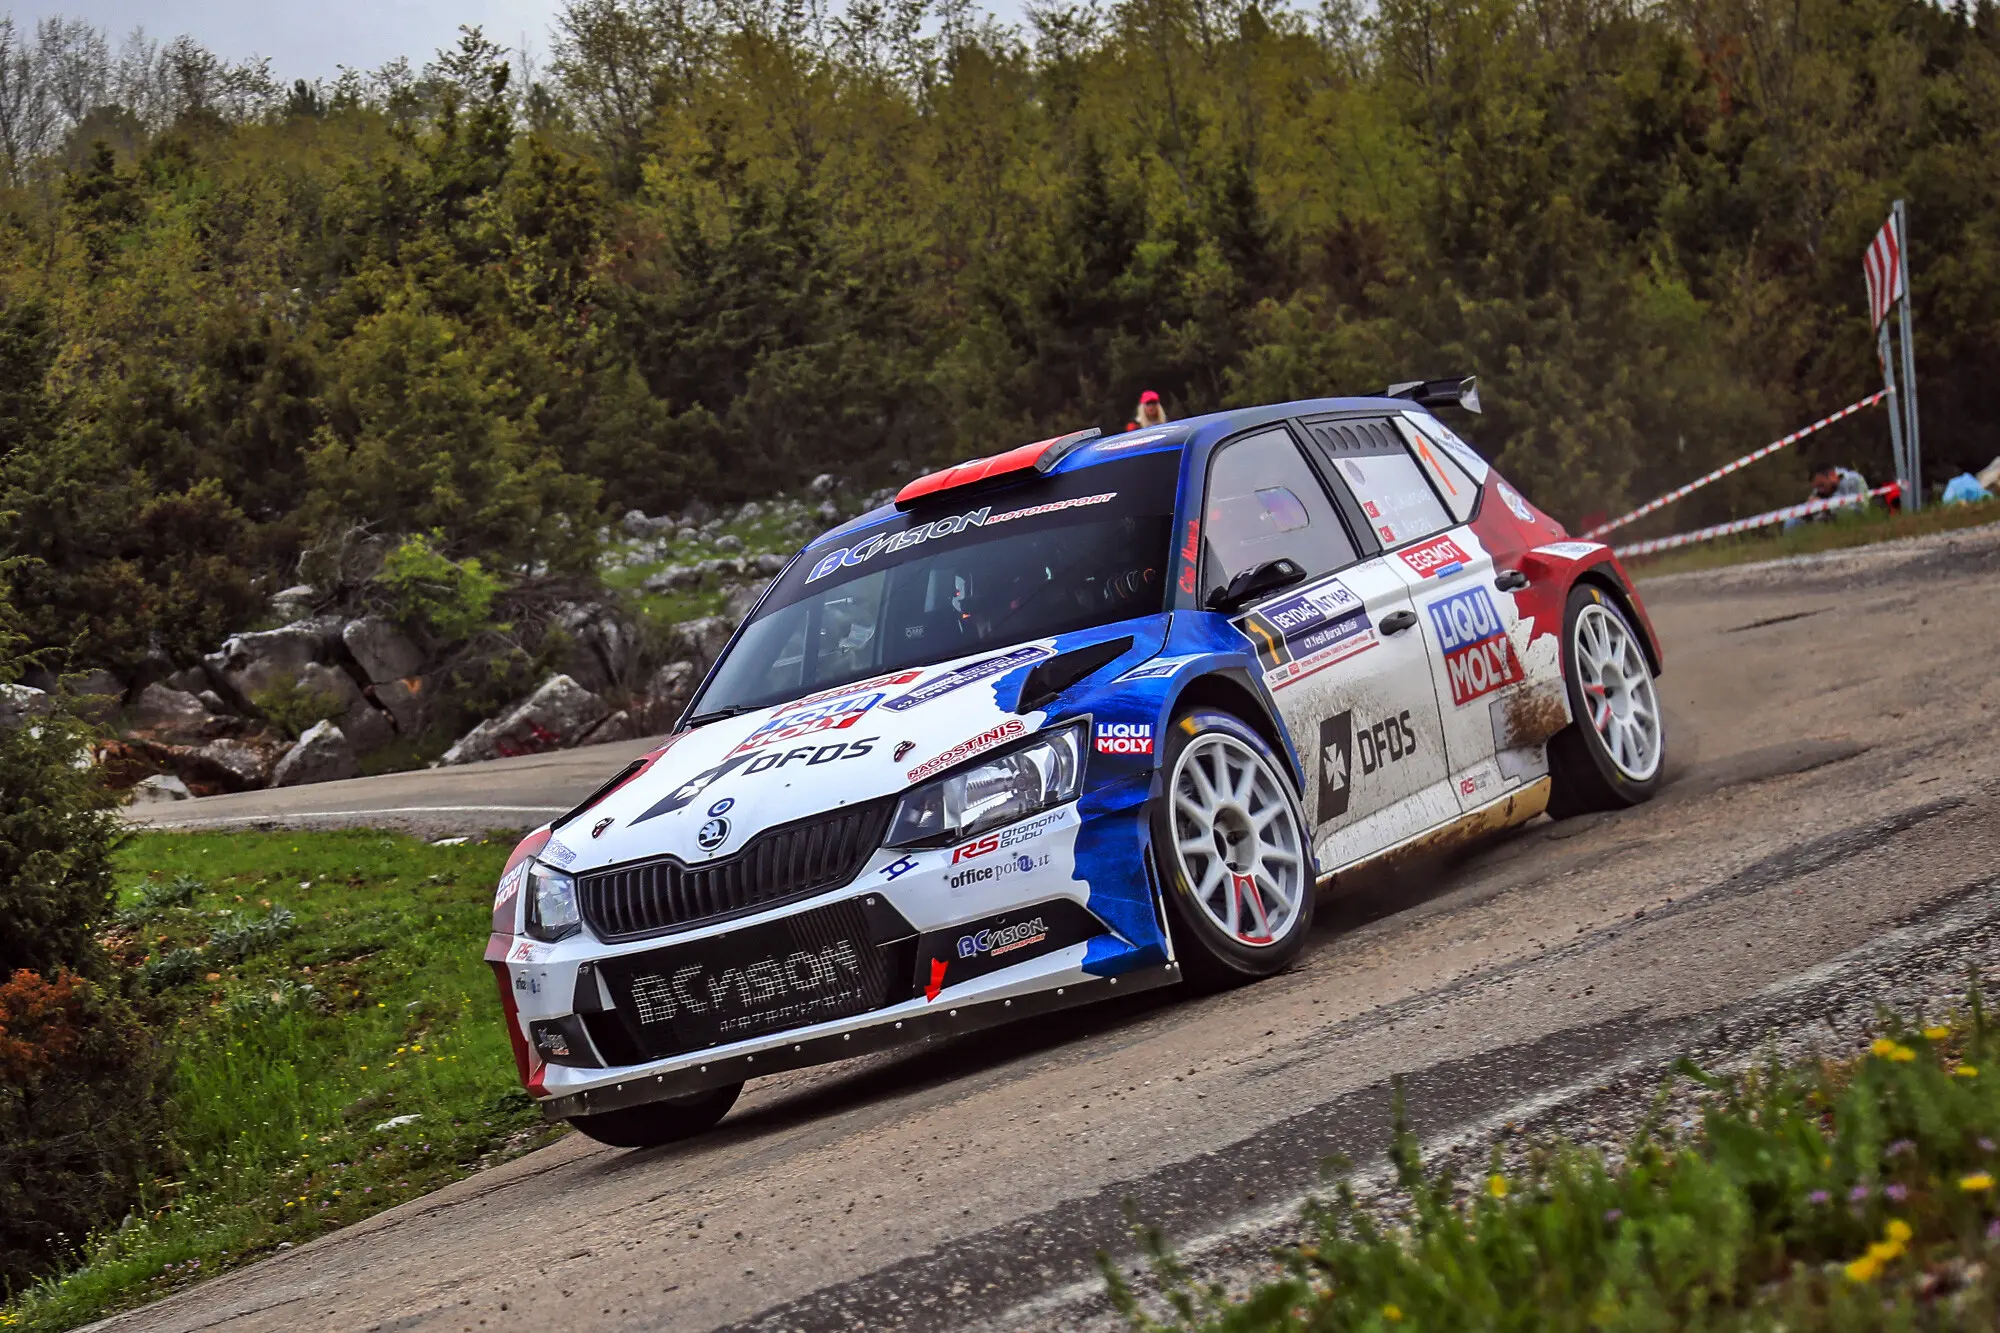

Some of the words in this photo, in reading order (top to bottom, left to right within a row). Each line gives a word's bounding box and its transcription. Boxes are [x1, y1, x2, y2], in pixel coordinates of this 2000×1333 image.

[985, 492, 1118, 525] MOTORSPORT
[1405, 541, 1461, 571] EGEMOT
[1273, 601, 1320, 628] BEYDAĞ
[1324, 627, 1342, 641] Bursa
[1432, 589, 1497, 649] LIQUI
[1246, 618, 1281, 664] 1
[1449, 637, 1514, 699] MOLY
[752, 693, 880, 736] LIQUI
[1098, 724, 1150, 738] LIQUI
[741, 736, 881, 776] DFDS
[908, 720, 1024, 779] NAGOSTINIS
[910, 764, 945, 784] IMPRESA
[946, 754, 967, 766] EDILE
[972, 744, 994, 755] VILLA
[995, 731, 1028, 744] SANTINA
[1097, 739, 1152, 752] MOLY
[1357, 710, 1416, 775] DFDS
[952, 834, 999, 865] RS
[1001, 811, 1066, 840] Otomotiv
[1000, 829, 1044, 848] Grubu
[991, 933, 1046, 956] MOTORSPORT
